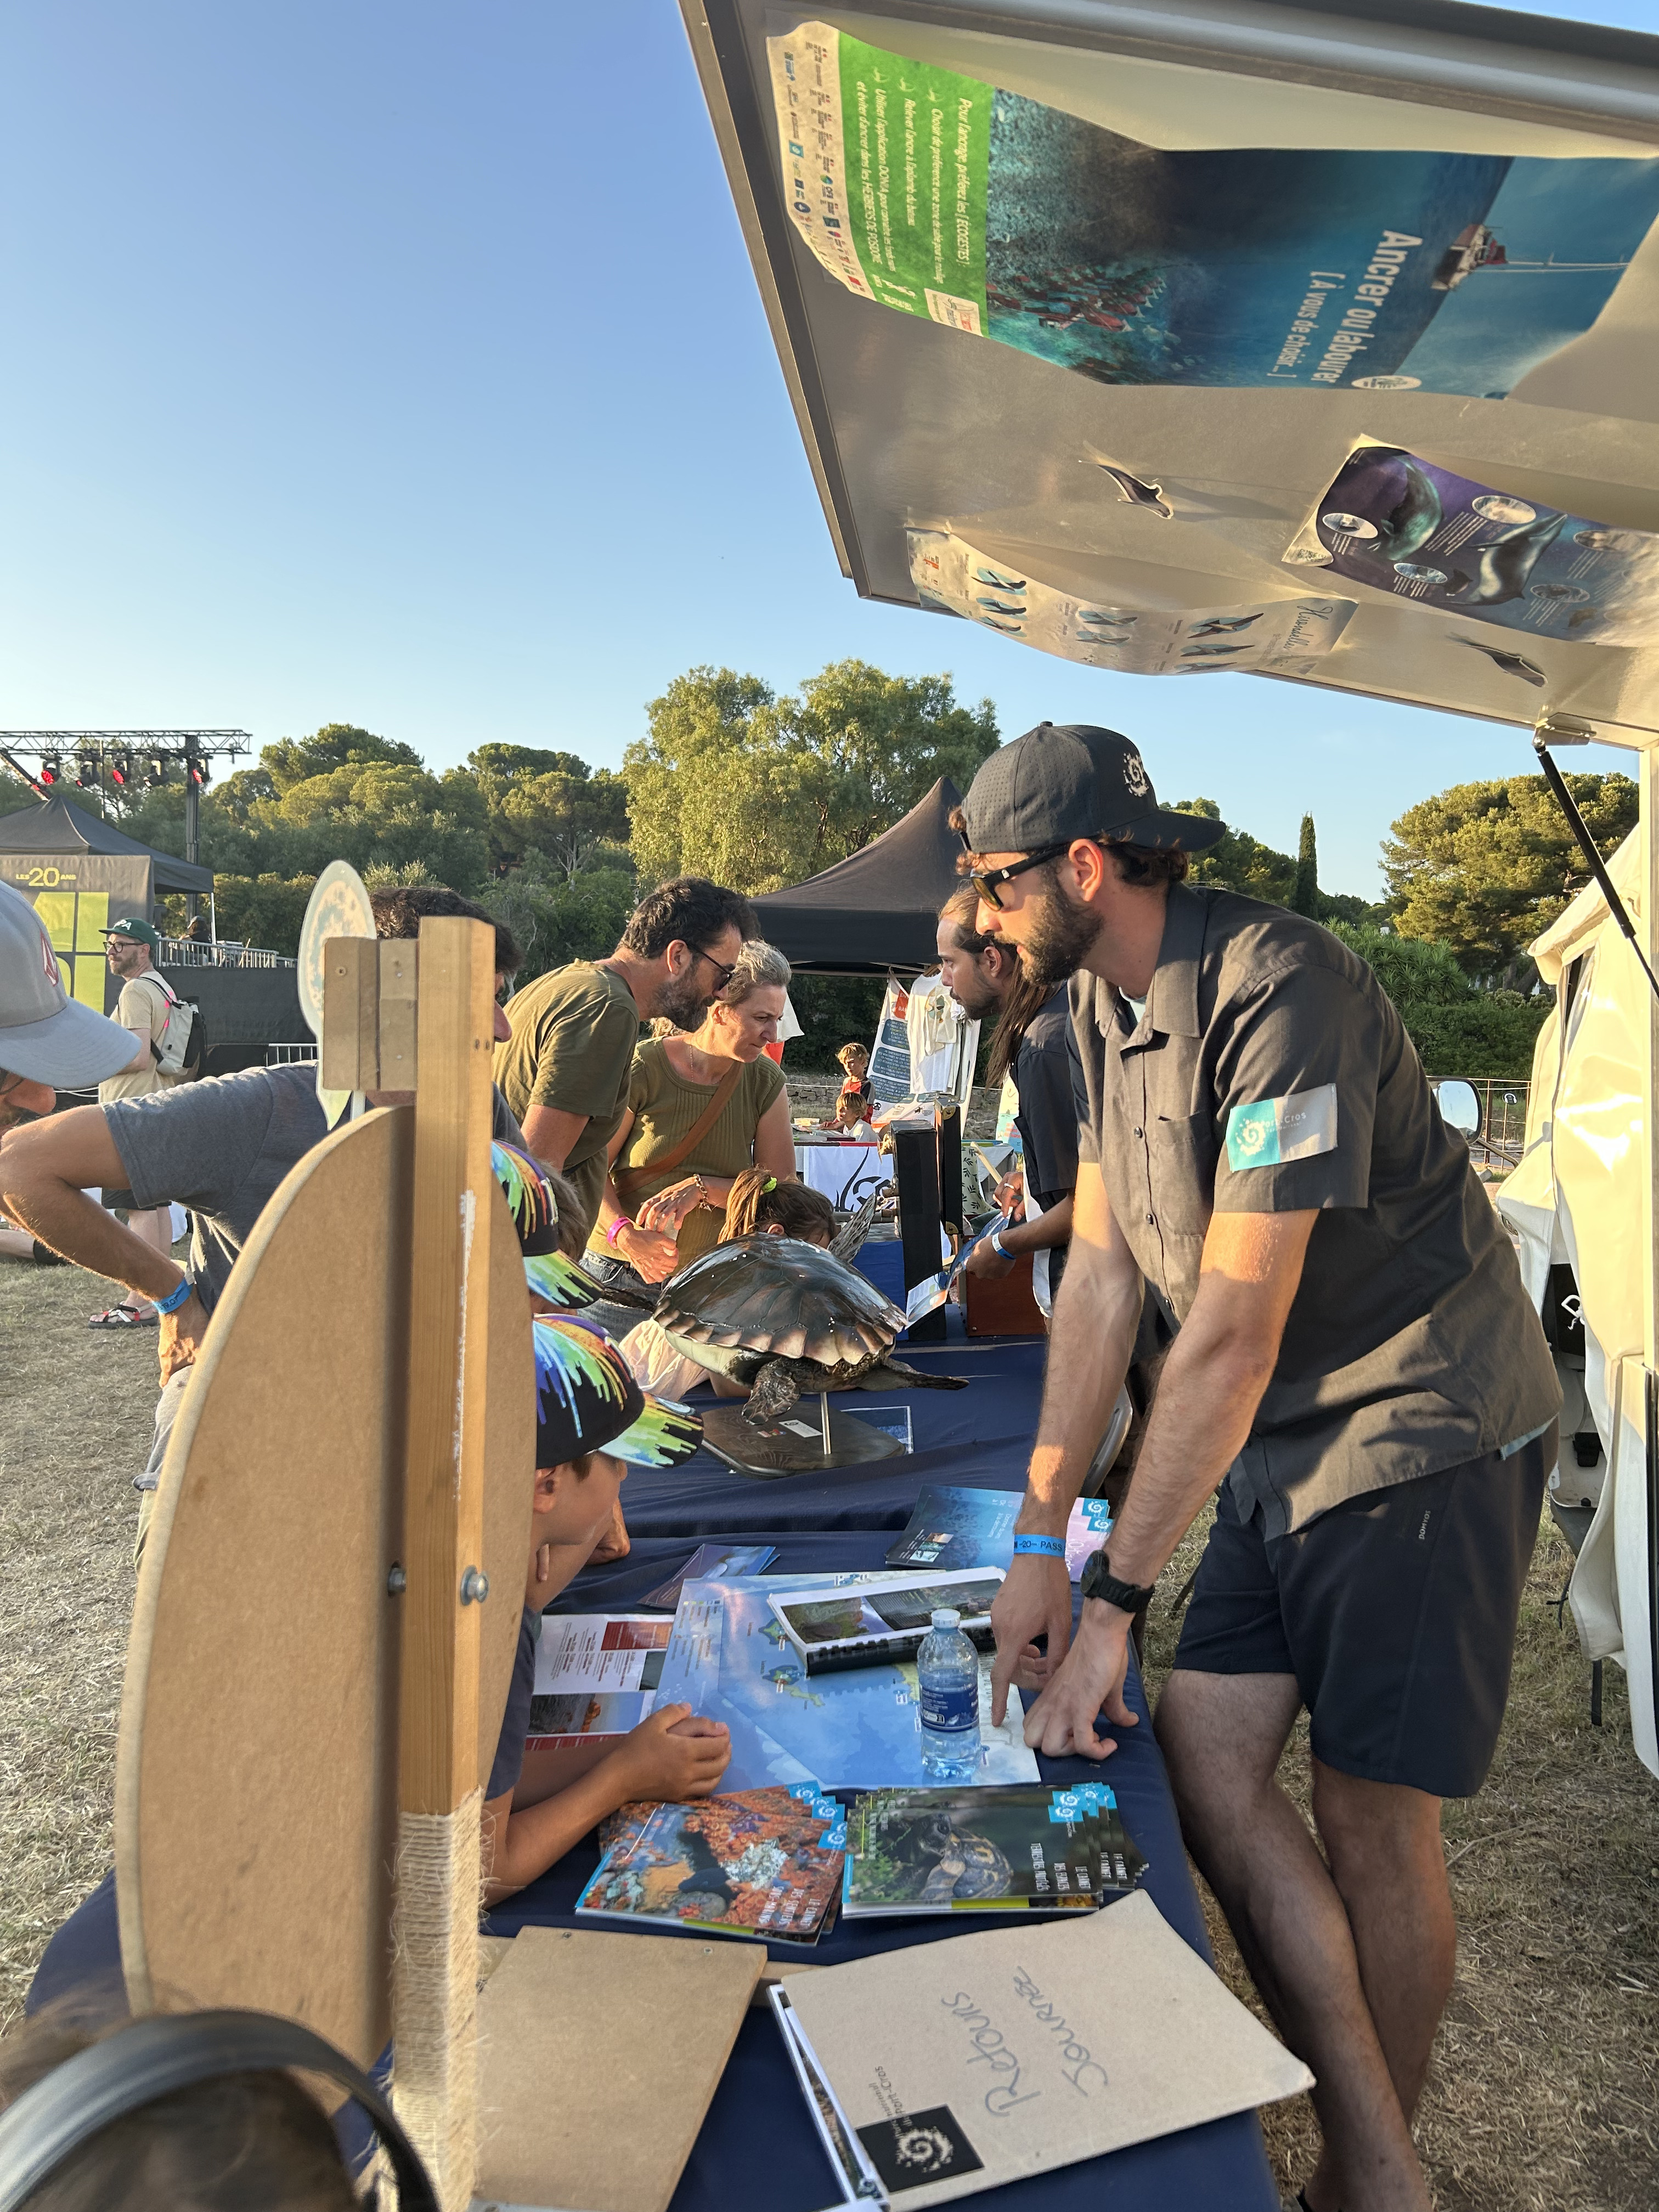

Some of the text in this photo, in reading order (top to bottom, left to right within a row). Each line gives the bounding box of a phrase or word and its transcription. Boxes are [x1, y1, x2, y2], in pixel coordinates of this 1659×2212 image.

[857, 81, 866, 91] et
[857, 92, 868, 116] éviter
[875, 89, 887, 117] Utiliser
[905, 99, 916, 128] Relever
[958, 98, 972, 121] Pour
[859, 116, 870, 148] d'ancrer
[932, 109, 943, 135] Choisir
[875, 118, 889, 164] l'application
[906, 129, 916, 154] l'ancre
[932, 137, 943, 146] de
[861, 149, 871, 167] dans
[929, 146, 943, 187] préférence
[862, 168, 872, 180] les
[906, 194, 917, 204] du
[957, 201, 969, 213] les
[866, 222, 878, 232] DE
[1297, 292, 1327, 318] vous
[1311, 230, 1423, 383] Ancrer ou labourer
[1291, 320, 1318, 332] de
[29, 867, 60, 887] 20
[1418, 1510, 1431, 1540] DOMYOS
[1041, 1541, 1063, 1551] PASS
[1054, 1863, 1066, 1871] DES
[759, 1886, 784, 1923] SOUS-MARINS
[779, 1888, 804, 1925] DES SENTIERS
[800, 1907, 817, 1927] CARNET
